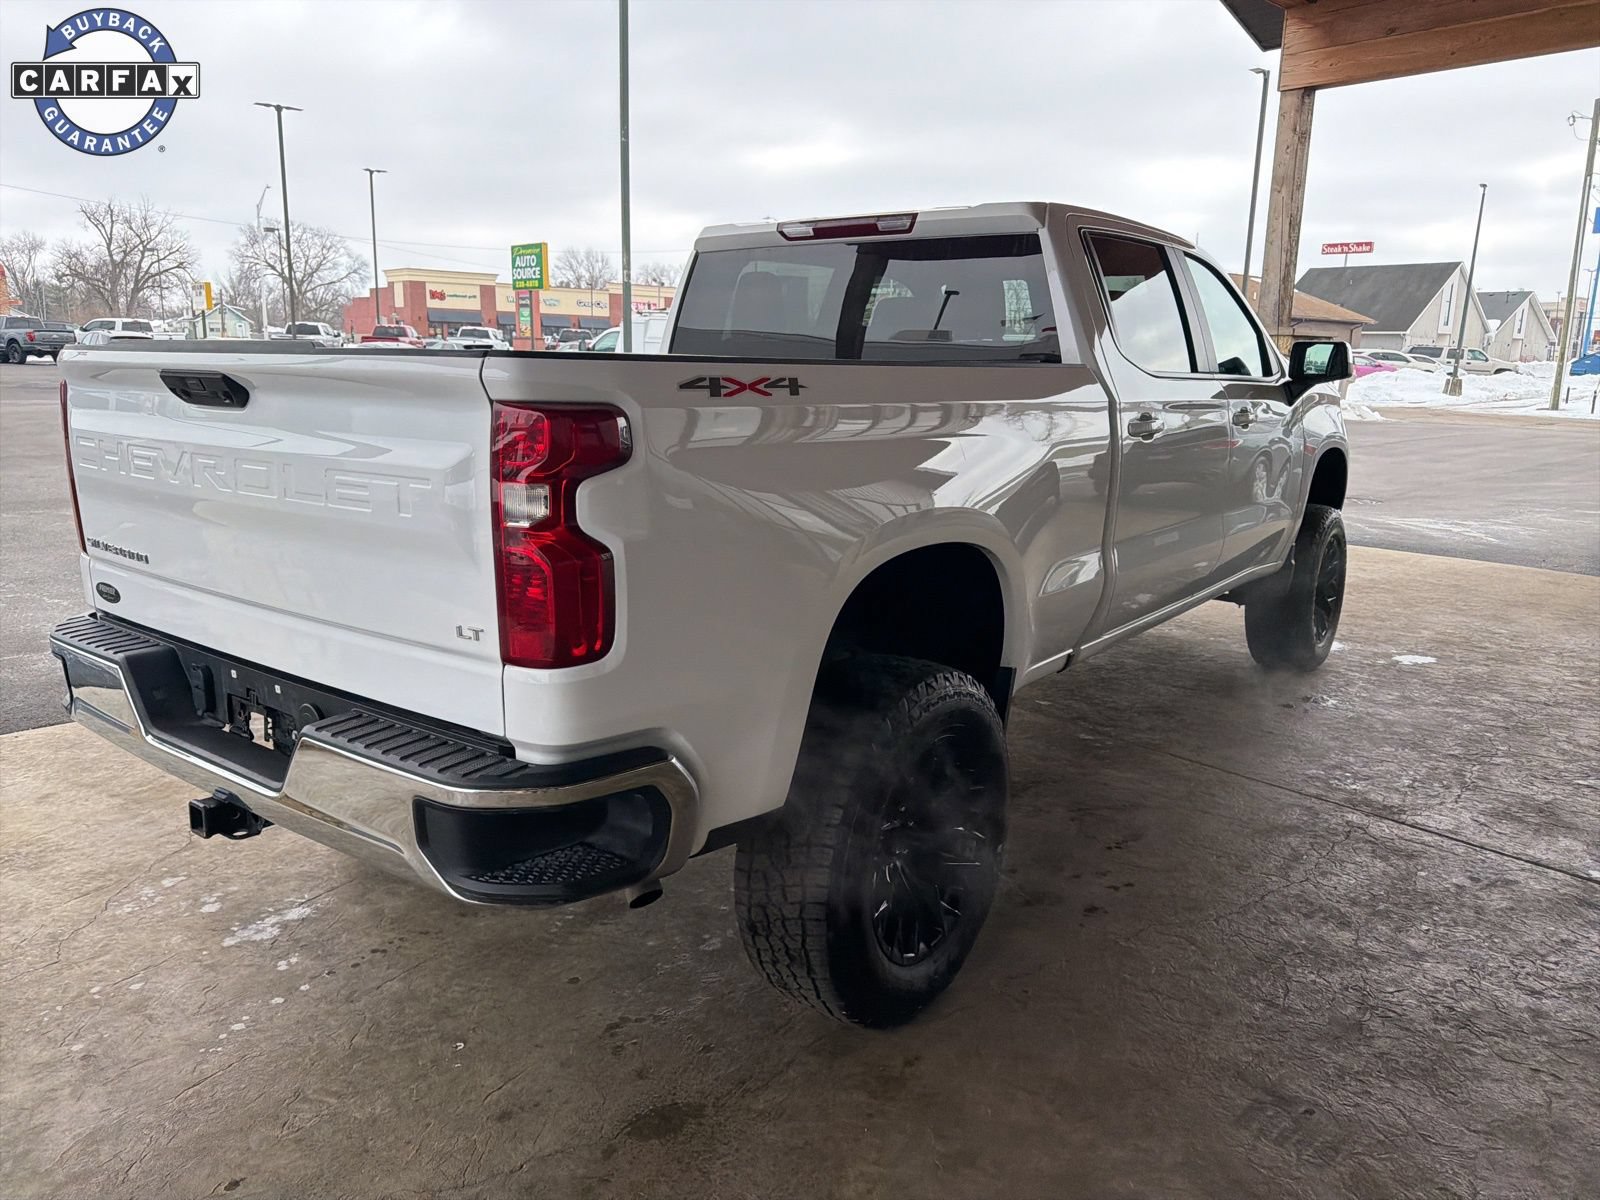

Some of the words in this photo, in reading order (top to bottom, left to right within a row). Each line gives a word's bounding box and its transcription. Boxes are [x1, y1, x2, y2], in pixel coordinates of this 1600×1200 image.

[1349, 243, 1371, 252] Shake
[515, 255, 537, 267] AUTO
[513, 267, 541, 279] SOURCE
[75, 435, 432, 517] CHEVROLET
[455, 625, 485, 641] LT
